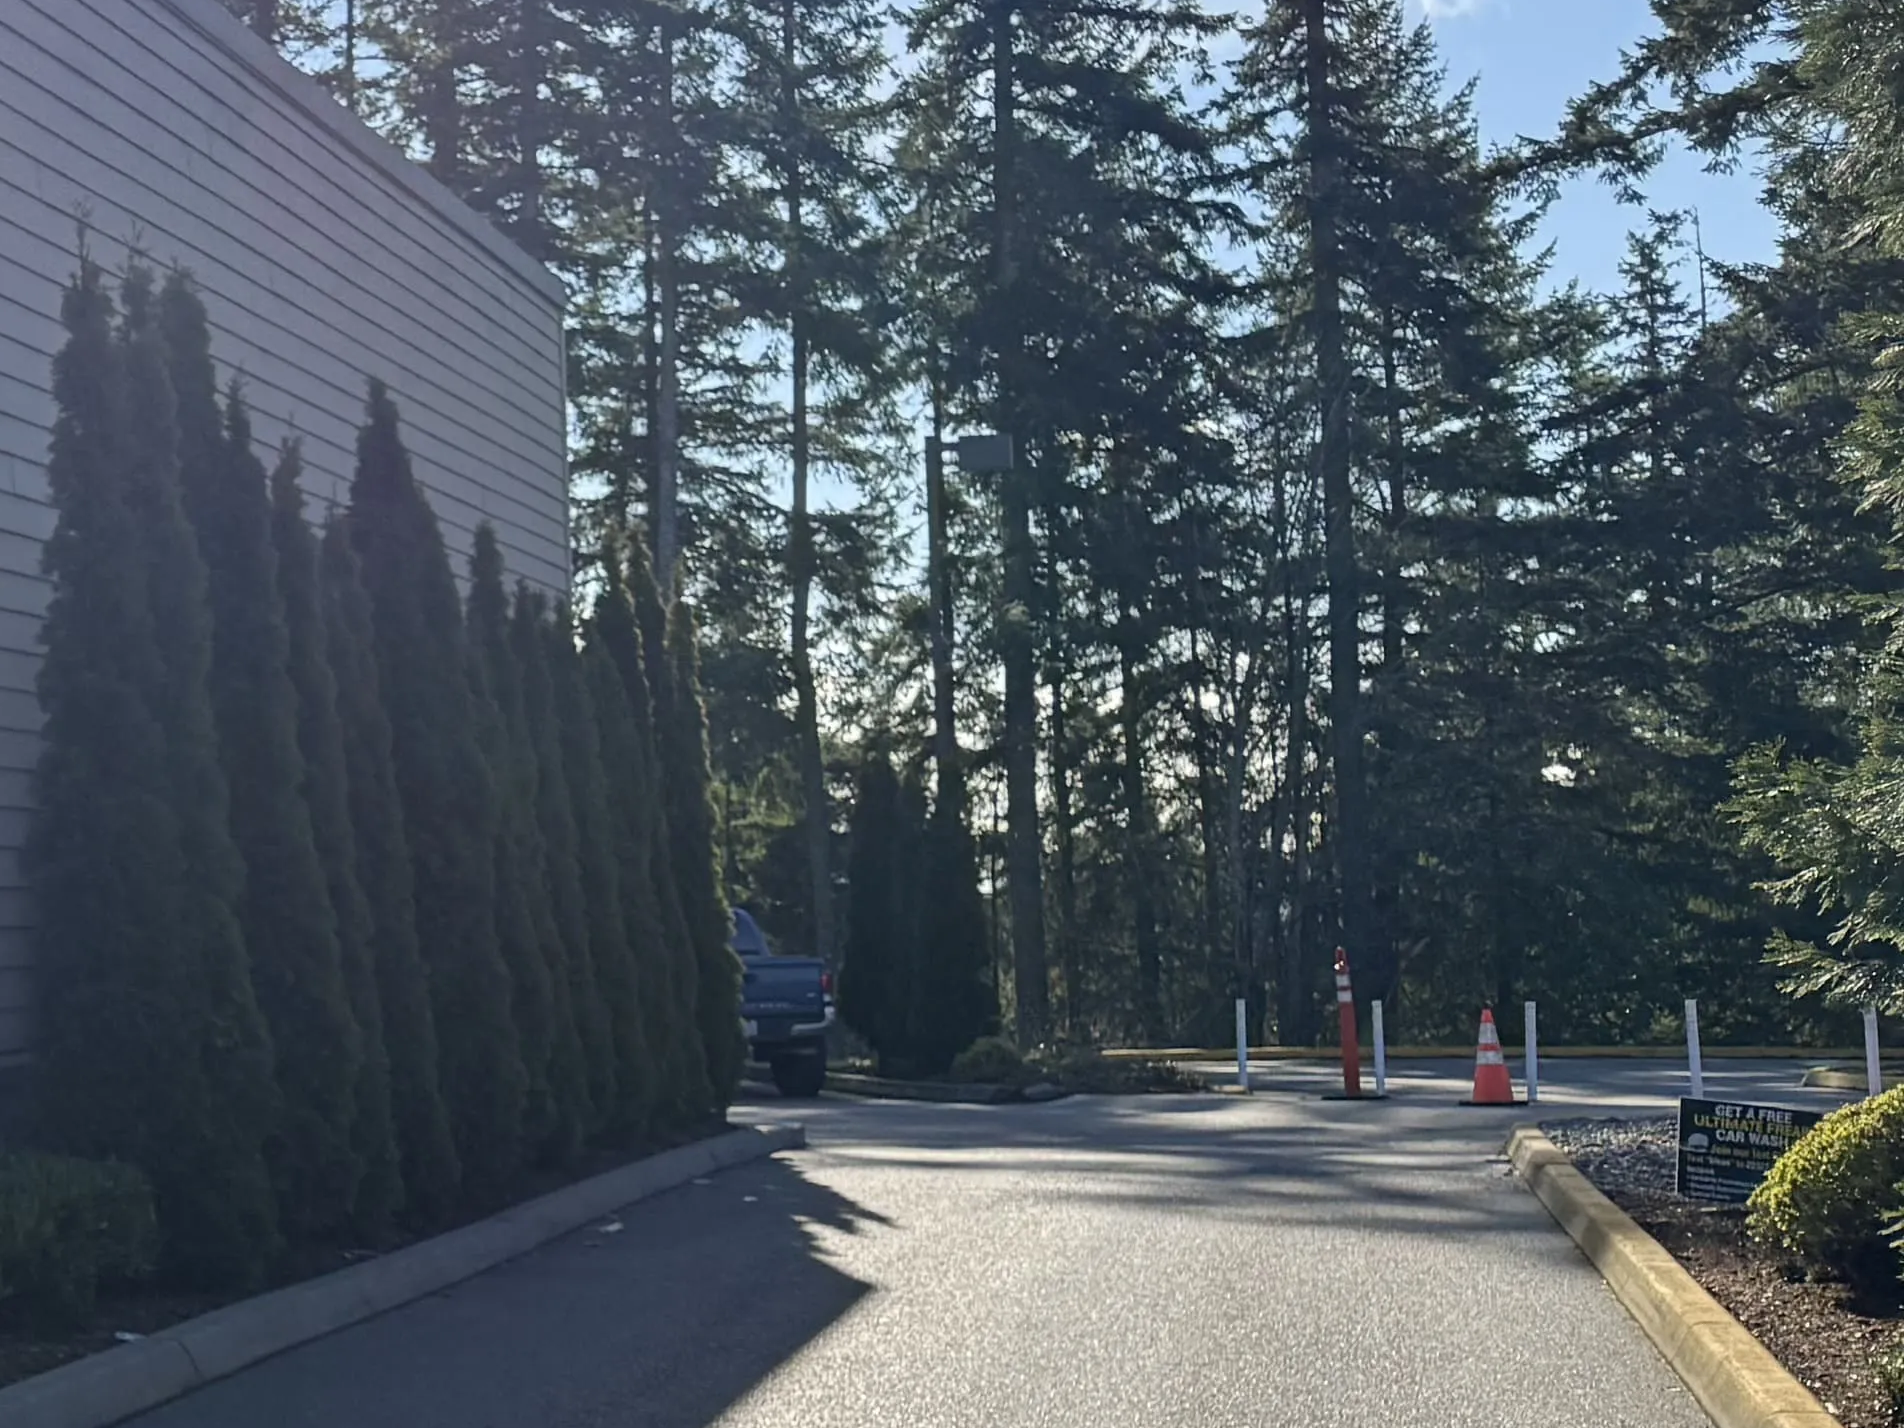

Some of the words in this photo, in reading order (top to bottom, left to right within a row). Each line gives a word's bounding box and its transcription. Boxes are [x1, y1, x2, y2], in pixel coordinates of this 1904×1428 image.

[1694, 1113, 1764, 1132] ULTIMATE
[1715, 1104, 1743, 1119] GET
[1745, 1107, 1755, 1120] A
[1758, 1109, 1793, 1124] FREE
[1715, 1129, 1745, 1143] CAR
[1748, 1133, 1789, 1149] WASH
